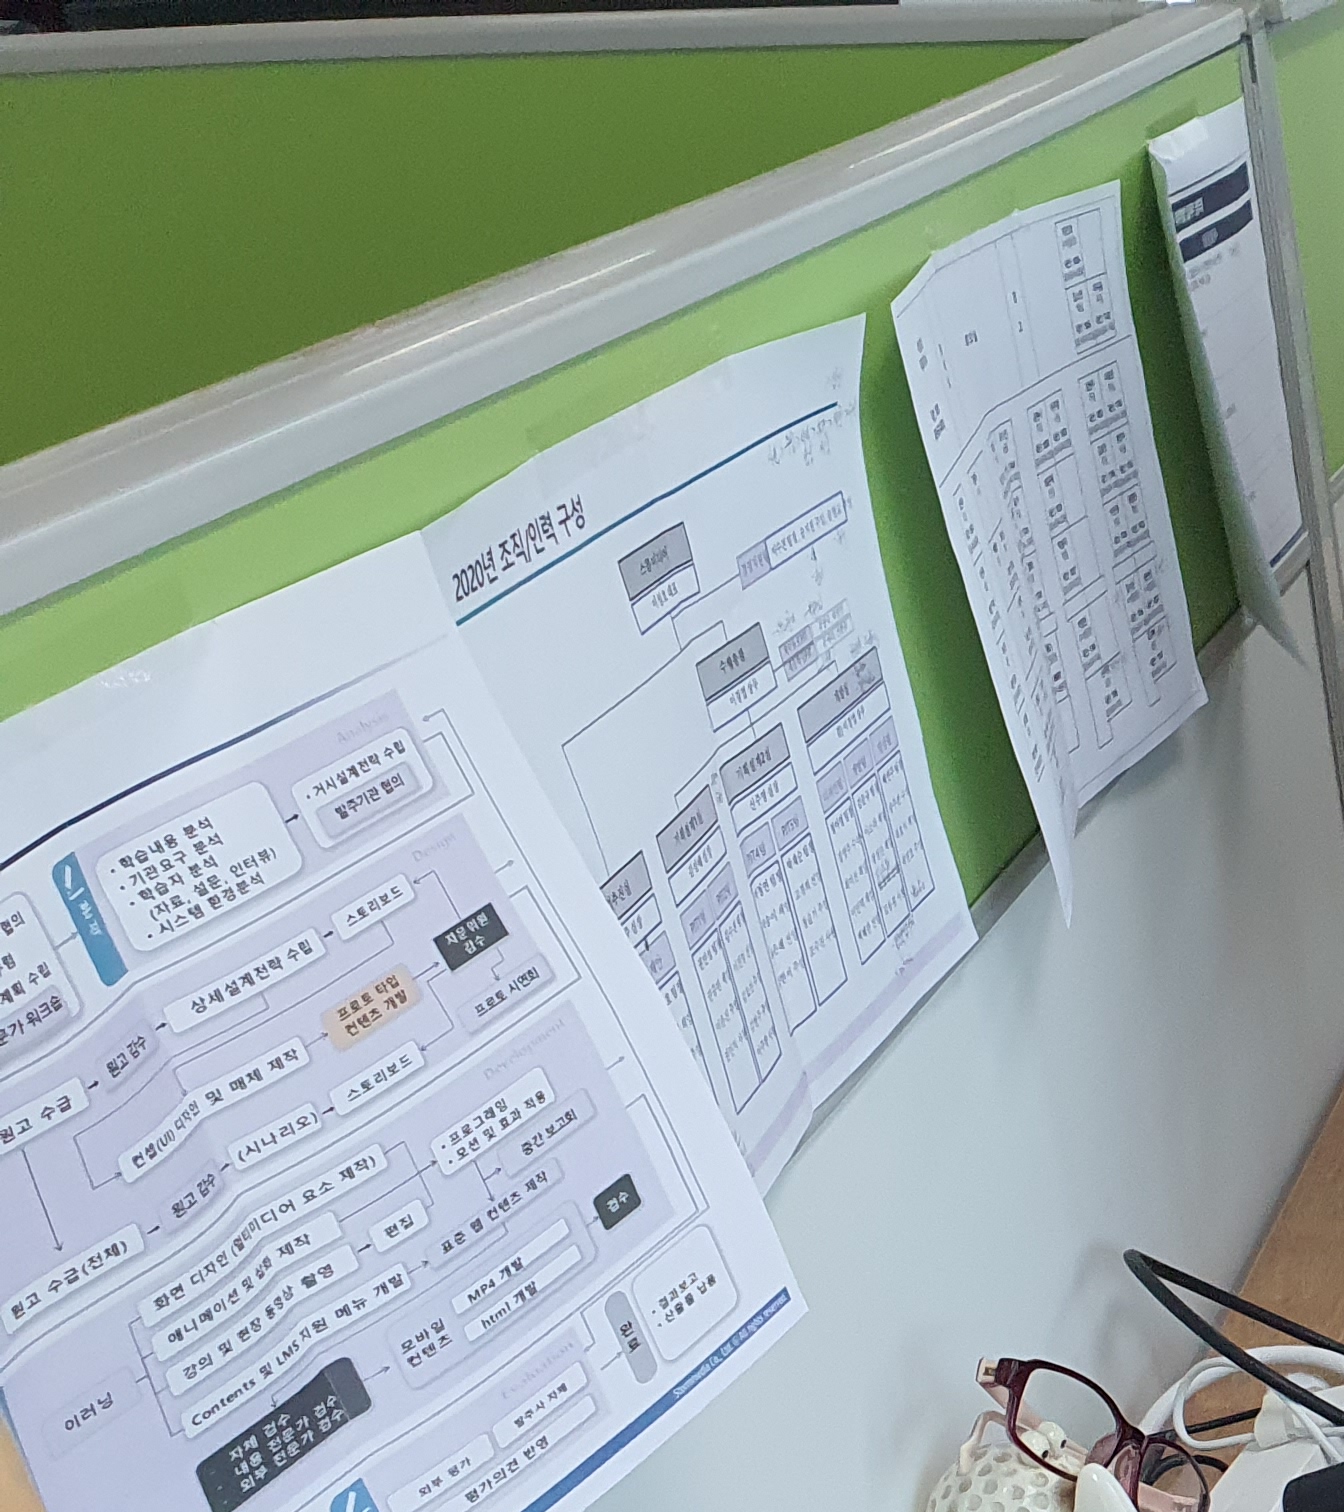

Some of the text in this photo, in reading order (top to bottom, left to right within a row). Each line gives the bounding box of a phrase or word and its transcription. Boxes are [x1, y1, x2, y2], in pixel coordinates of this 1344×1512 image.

[452, 493, 586, 602] 2020년 조직/인력 구성
[118, 834, 179, 870] 학습내용
[129, 851, 188, 887] 기관요구
[137, 871, 185, 903] 학습자
[158, 906, 206, 935] 시스템
[345, 885, 405, 928] 스토리보드
[189, 954, 285, 1015] 상세설계전략
[345, 1052, 414, 1102] 스토리보드
[39, 1094, 74, 1122] 수급
[236, 1110, 321, 1164] (시나리오)
[153, 1285, 187, 1312] 화면
[302, 1179, 335, 1205] 요소
[466, 1277, 498, 1305] MP4
[479, 1301, 513, 1330] html
[400, 1317, 446, 1355] 모바일
[182, 1351, 215, 1382] 강의
[190, 1376, 257, 1427] Contents
[275, 1338, 301, 1368] LMS
[63, 1390, 116, 1433] 이러닝
